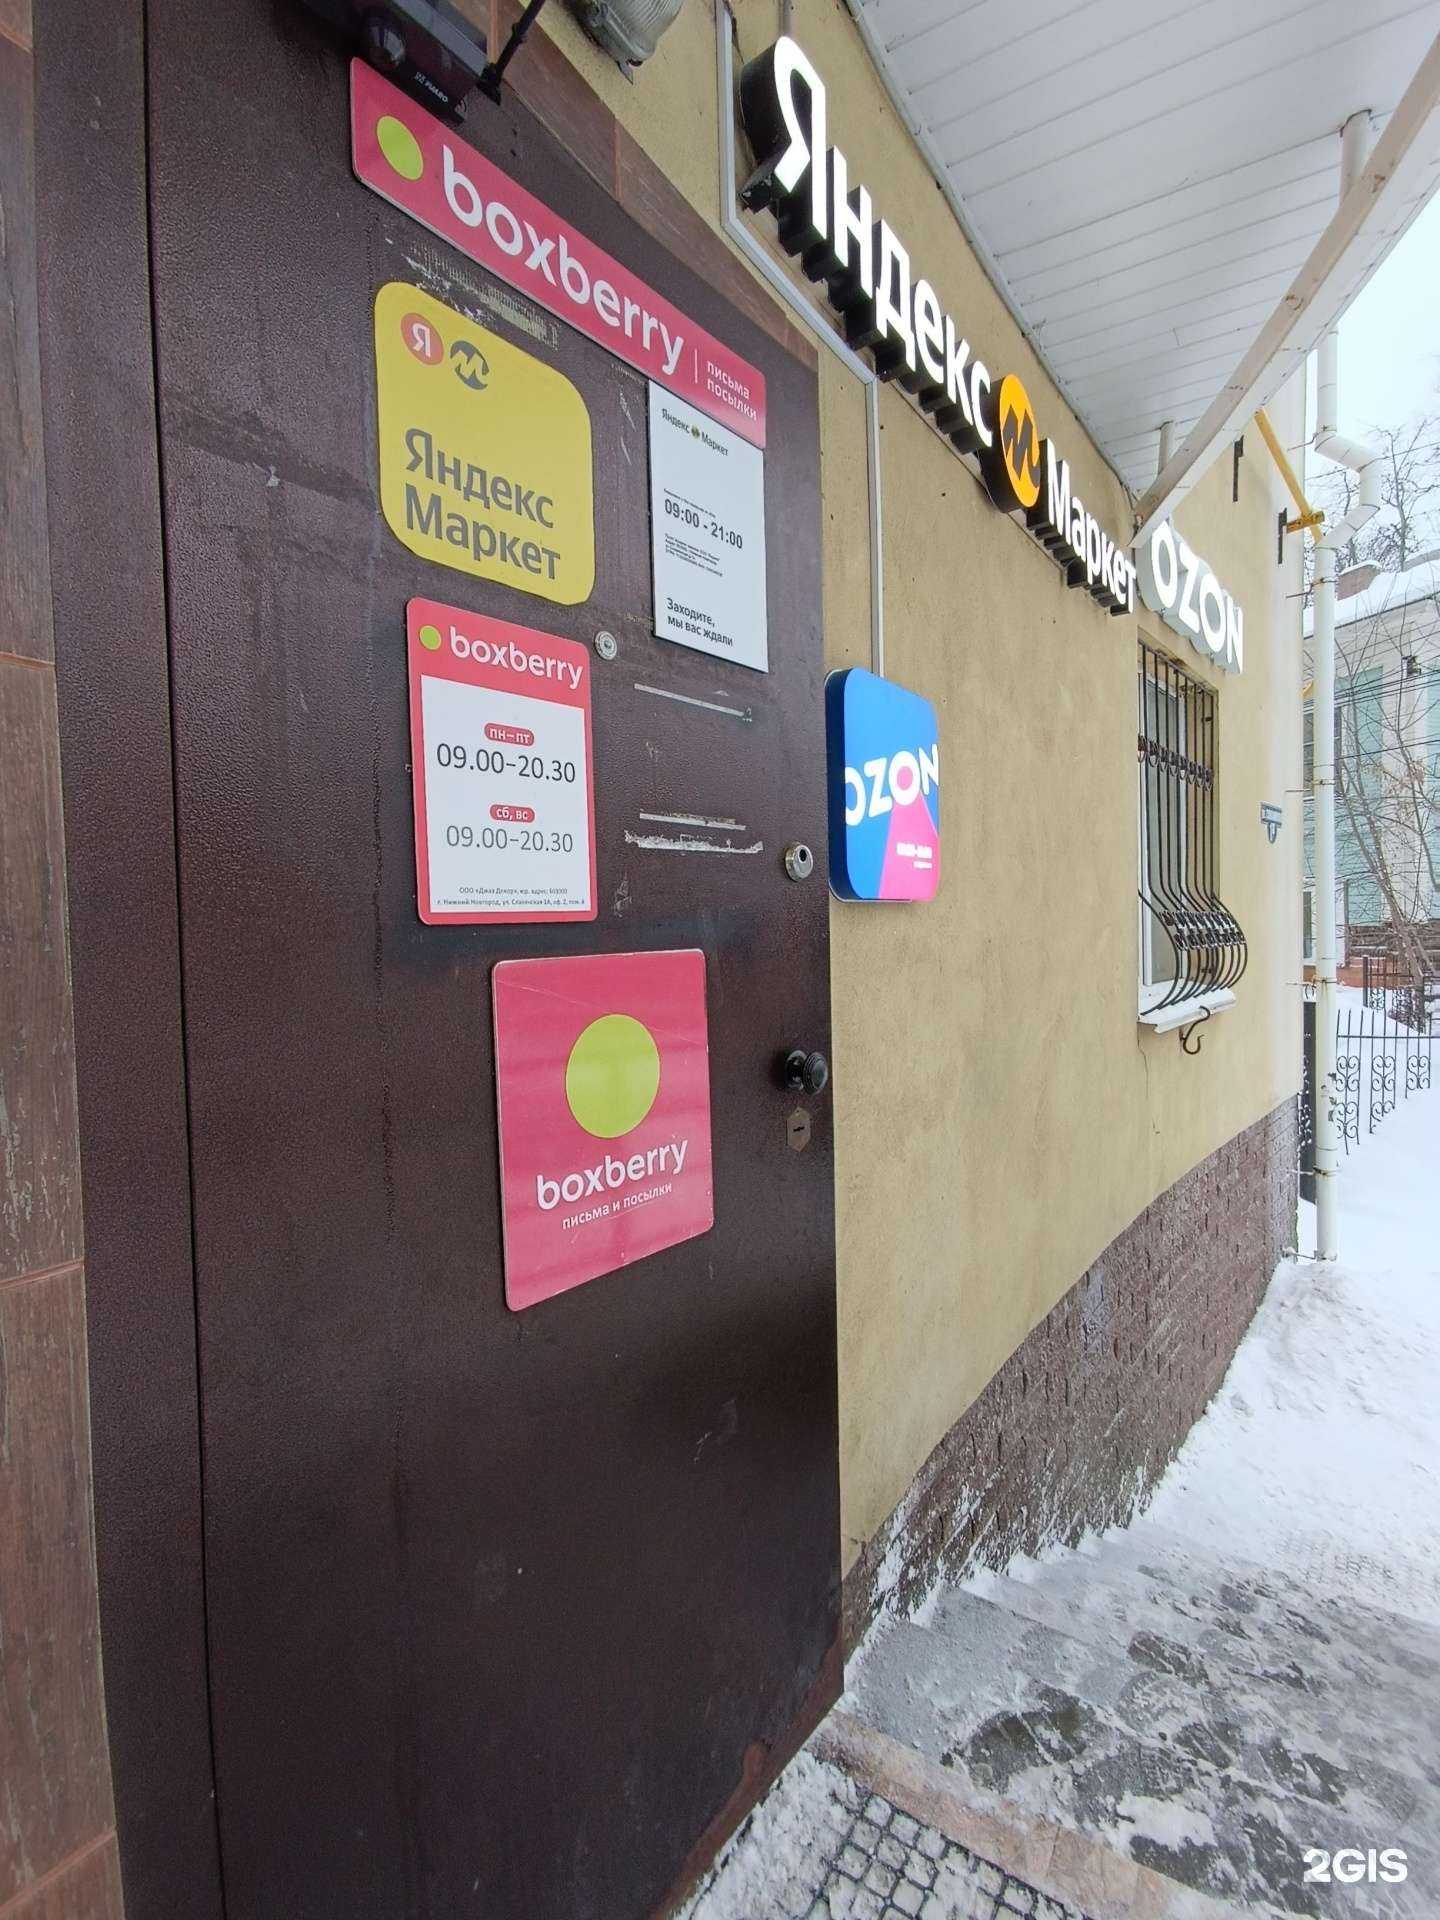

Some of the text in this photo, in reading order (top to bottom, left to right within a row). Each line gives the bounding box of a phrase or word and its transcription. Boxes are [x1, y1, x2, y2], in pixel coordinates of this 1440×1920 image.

[443, 144, 684, 375] boxberry
[772, 35, 992, 448] Яндекс
[1046, 440, 1137, 615] Маркет
[707, 360, 750, 400] письма
[707, 378, 757, 421] посылки
[661, 407, 729, 457] Яндекс Маркет
[404, 427, 554, 529] Яндекс
[404, 482, 561, 580] Маркет
[664, 498, 700, 528] 09:00
[711, 521, 743, 549] 21:00
[666, 597, 715, 628] Заходите,
[1151, 520, 1244, 672] OZON
[667, 615, 733, 647] мы вас ждали
[449, 625, 584, 690] boxberry
[436, 742, 577, 783] 09.00-20.30
[844, 743, 939, 827] OZON
[496, 806, 513, 821] сб,
[446, 825, 574, 853] 09.00-20.30
[535, 1139, 689, 1211] boxberry
[562, 1181, 674, 1230] письма и посылки
